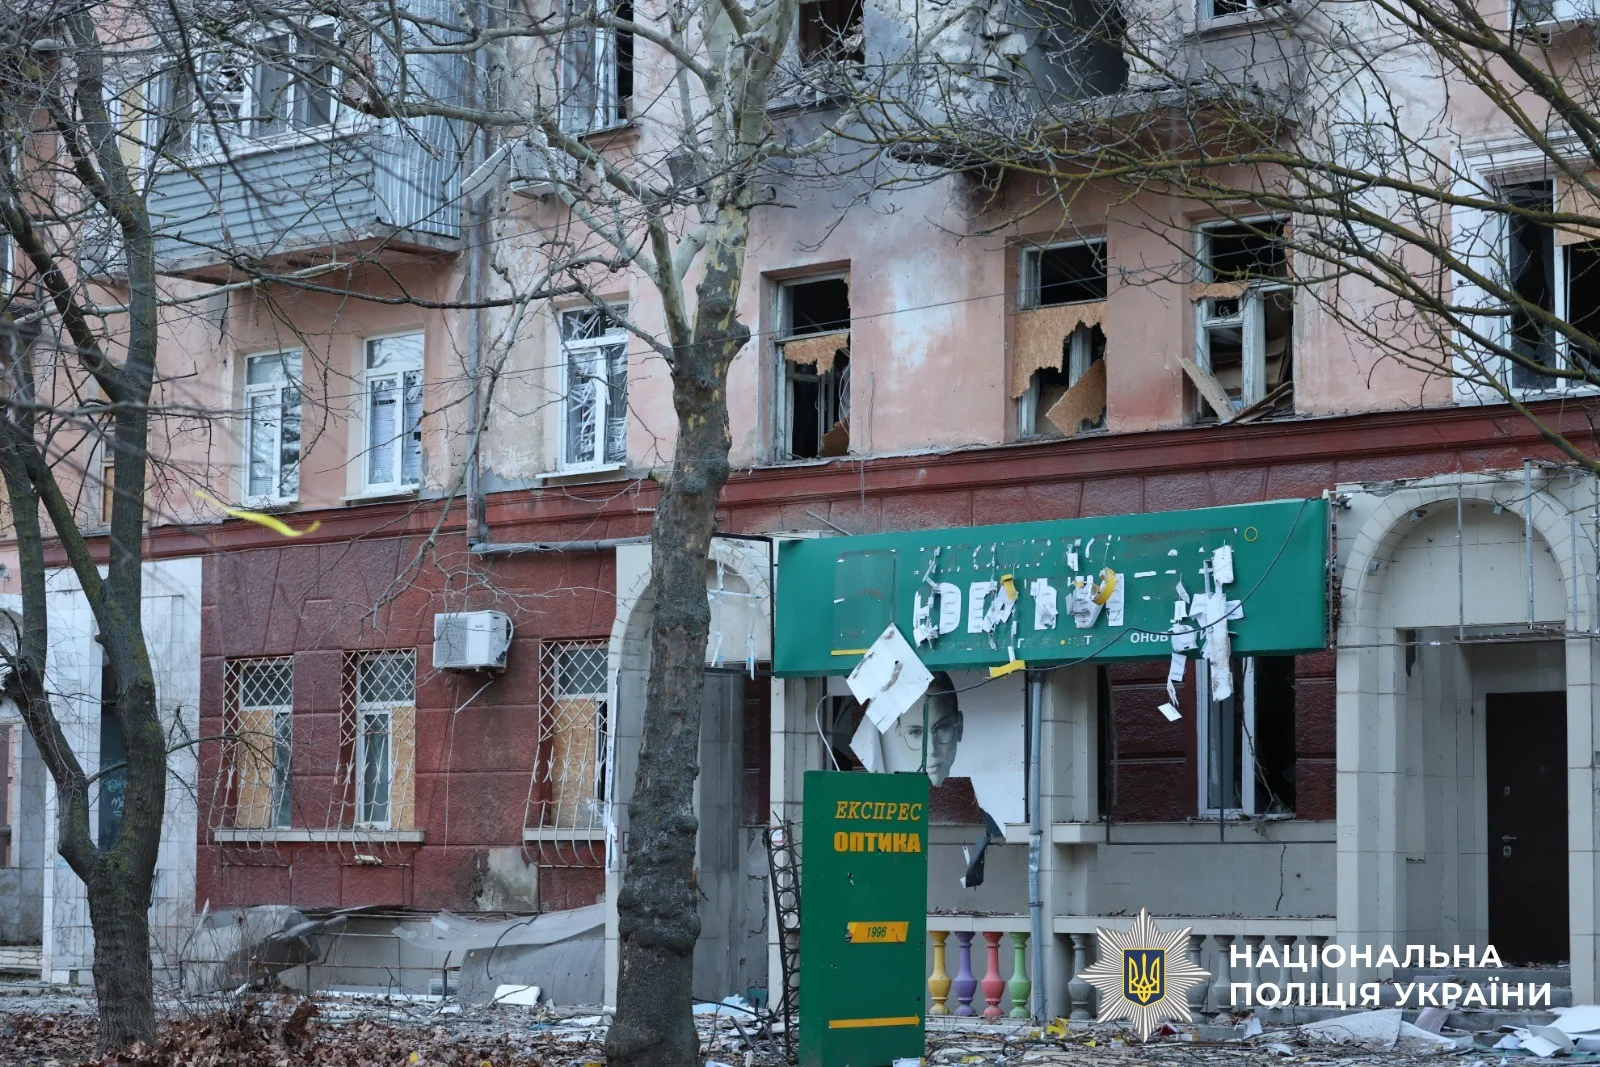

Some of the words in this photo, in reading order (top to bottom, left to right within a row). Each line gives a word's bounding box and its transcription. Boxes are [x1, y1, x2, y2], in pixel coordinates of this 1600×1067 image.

[834, 801, 922, 821] ЕКСПРЕС
[833, 831, 921, 853] ОПТИКА
[867, 926, 887, 938] 1996
